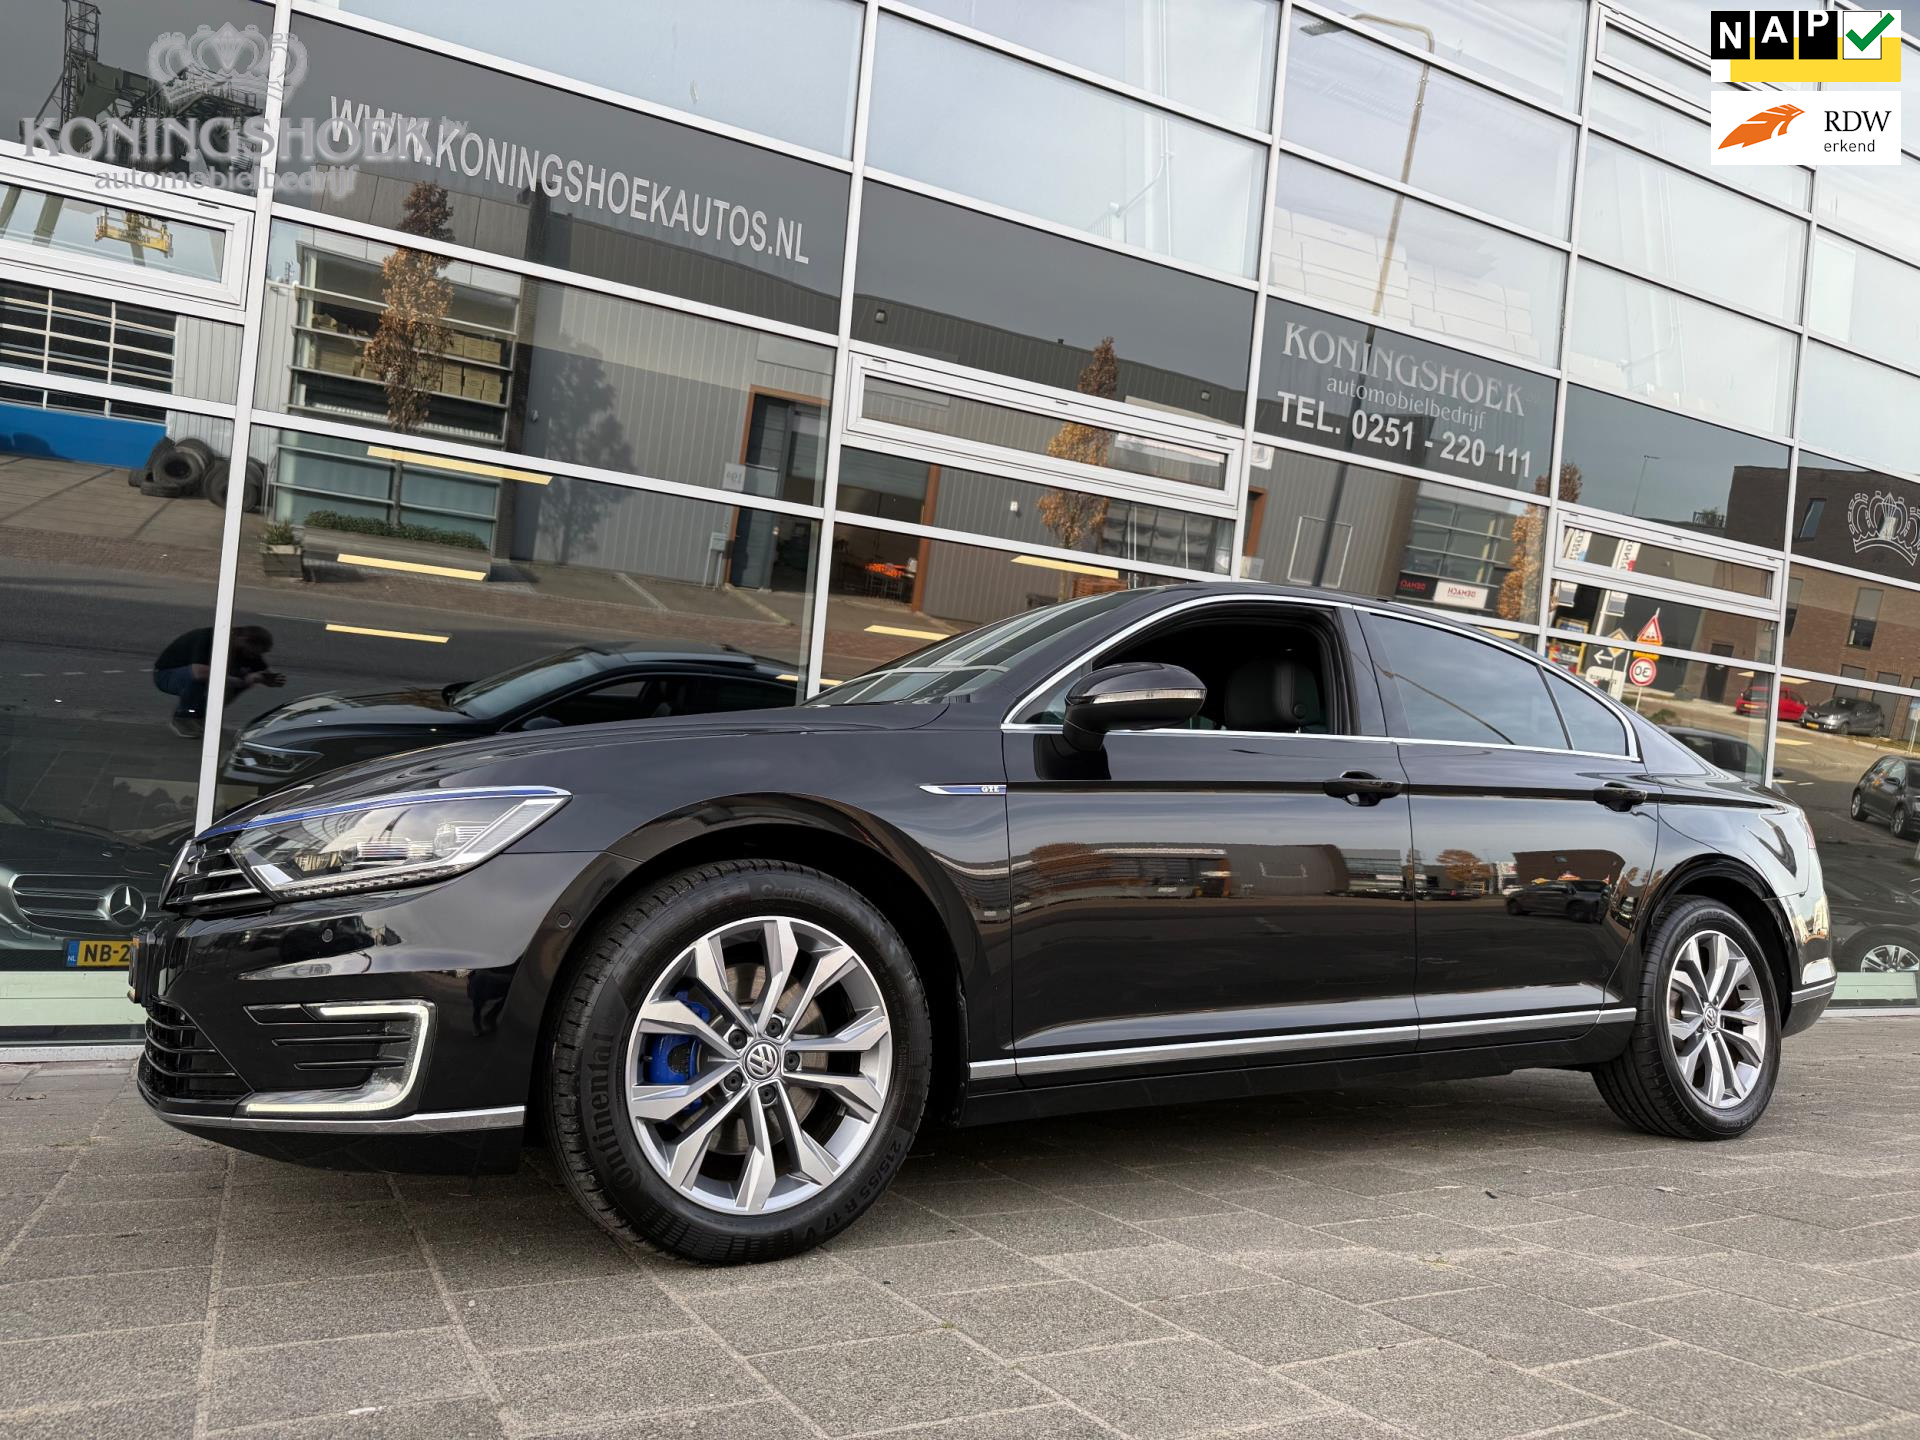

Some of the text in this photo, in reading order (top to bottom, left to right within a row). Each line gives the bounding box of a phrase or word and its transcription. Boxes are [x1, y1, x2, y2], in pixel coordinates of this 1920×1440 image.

[330, 96, 810, 264] WWW.KONINGSHOEKAUTOS.NL
[1282, 321, 1525, 417] KONINGSHOEK
[1327, 375, 1487, 432] automobielbedrijf
[1277, 390, 1341, 435] TEL.
[1352, 409, 1414, 451] 0251
[1440, 431, 1485, 467] 220
[1494, 444, 1531, 478] 111
